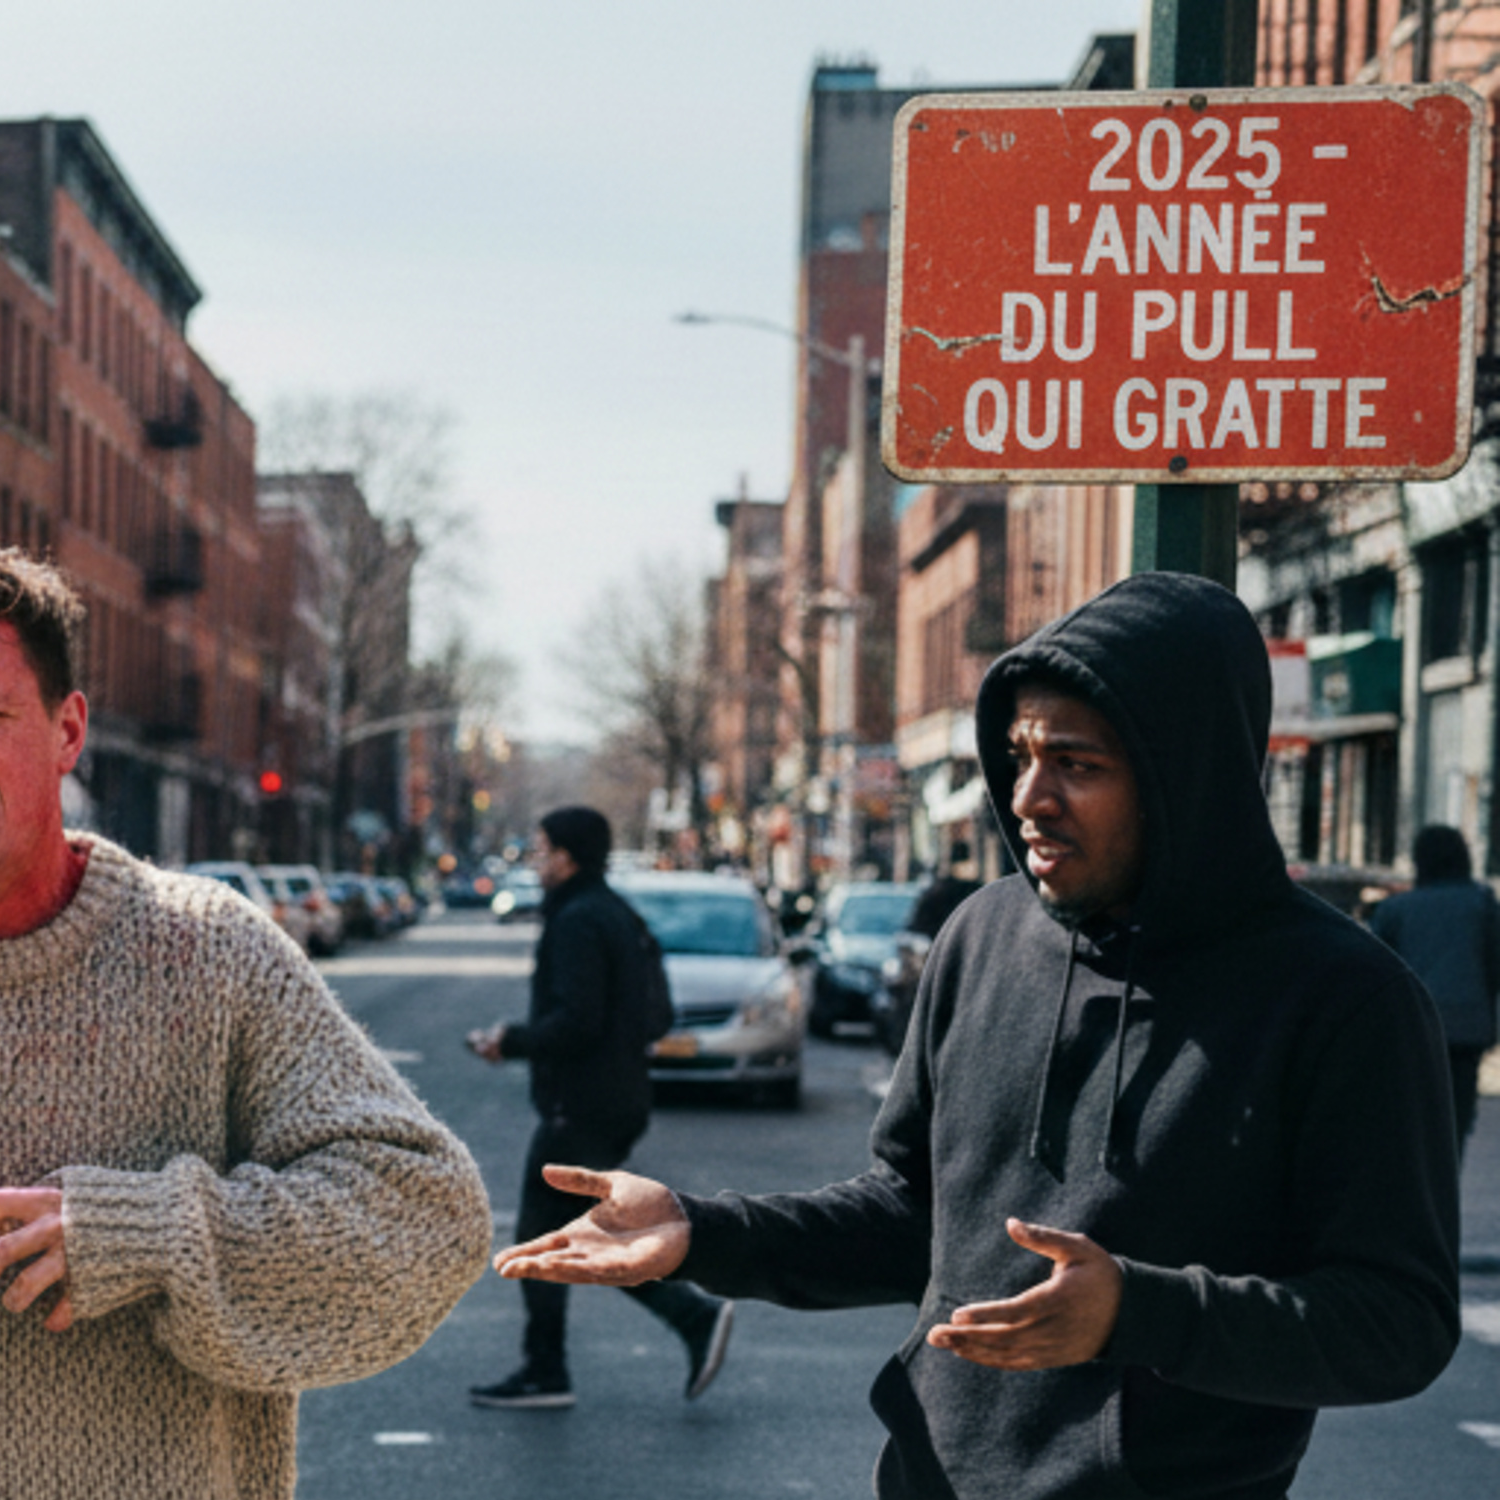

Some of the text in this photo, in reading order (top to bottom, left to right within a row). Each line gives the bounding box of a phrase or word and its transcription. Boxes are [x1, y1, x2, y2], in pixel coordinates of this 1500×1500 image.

[1088, 116, 1348, 192] 2025 -
[1033, 190, 1327, 276] L'ANNÉE
[1000, 290, 1318, 363] DU PULL
[963, 376, 1387, 455] QUI GRATTE
